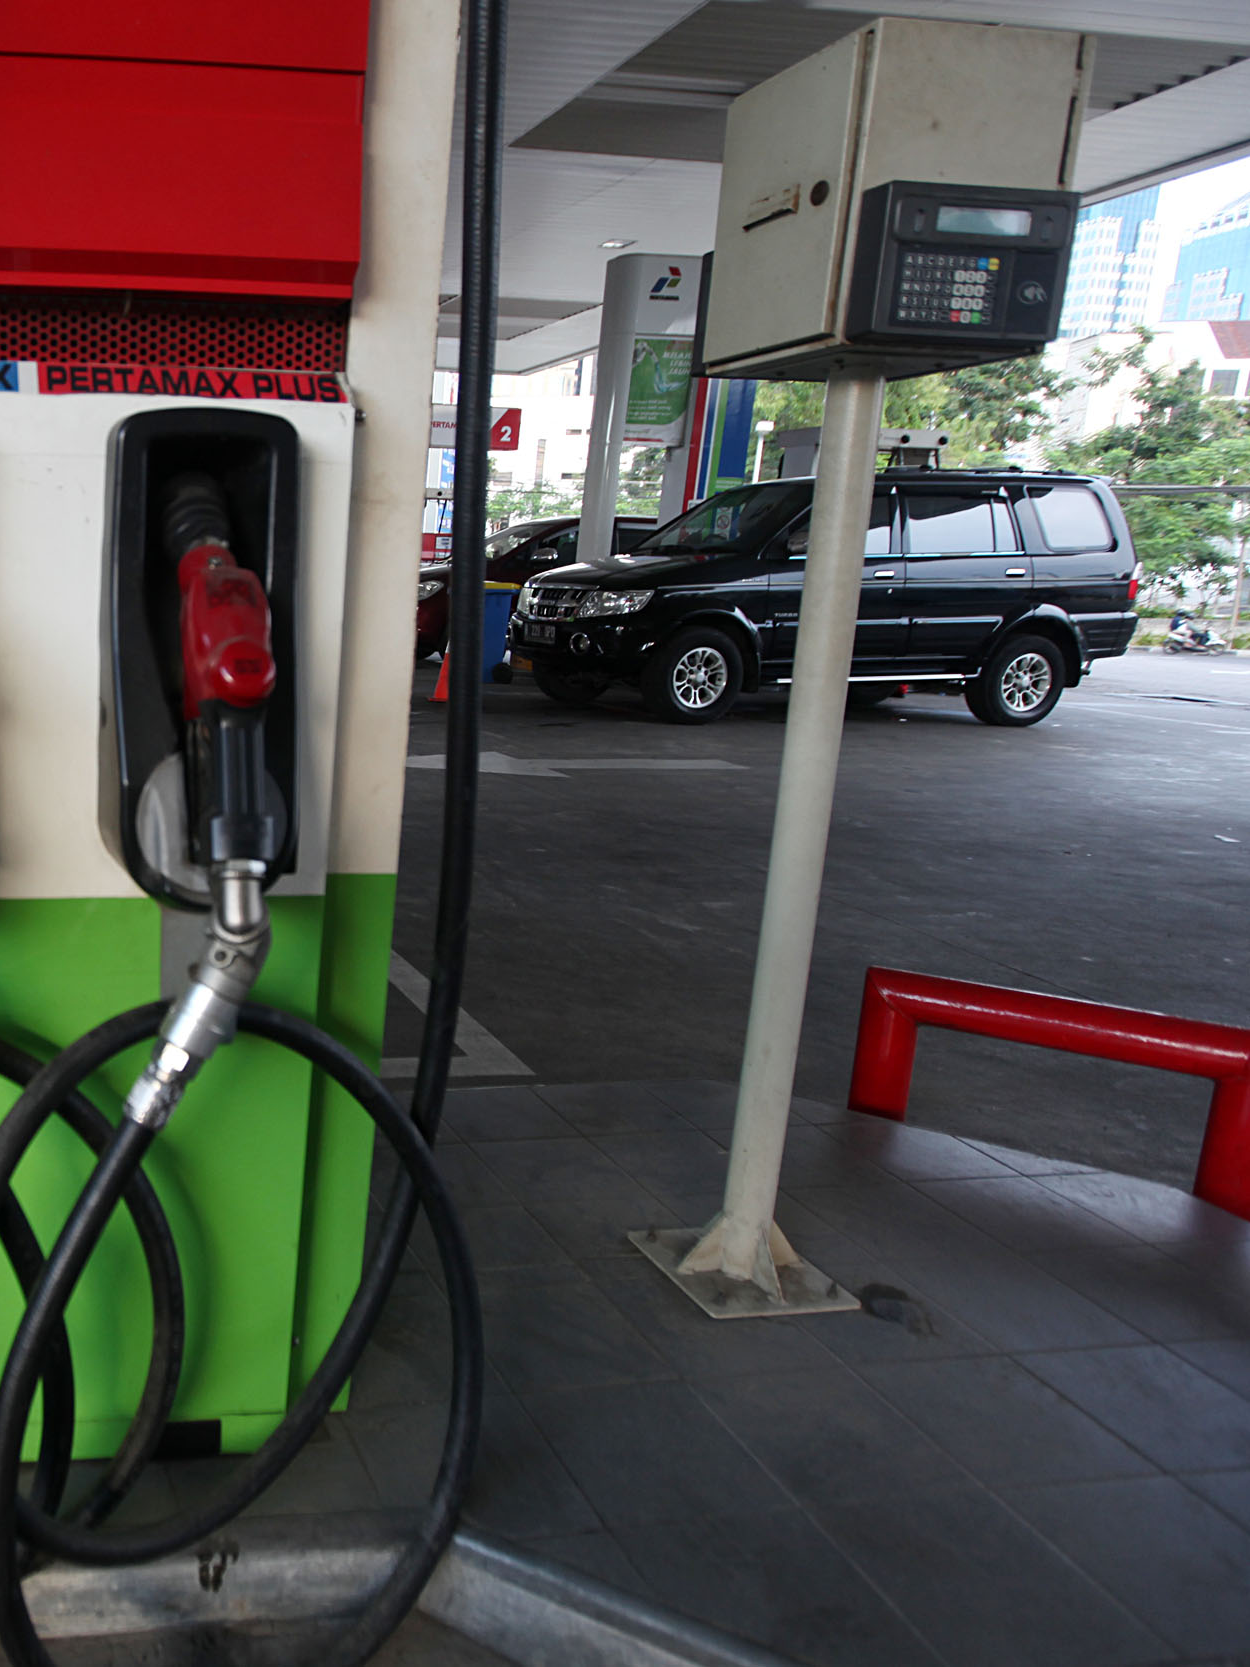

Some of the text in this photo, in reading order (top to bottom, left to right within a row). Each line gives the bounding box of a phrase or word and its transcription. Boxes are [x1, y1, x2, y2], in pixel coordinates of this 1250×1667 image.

[46, 364, 340, 402] PERTAMAX PLUS
[431, 421, 457, 430] ERTAM
[500, 426, 512, 442] 2
